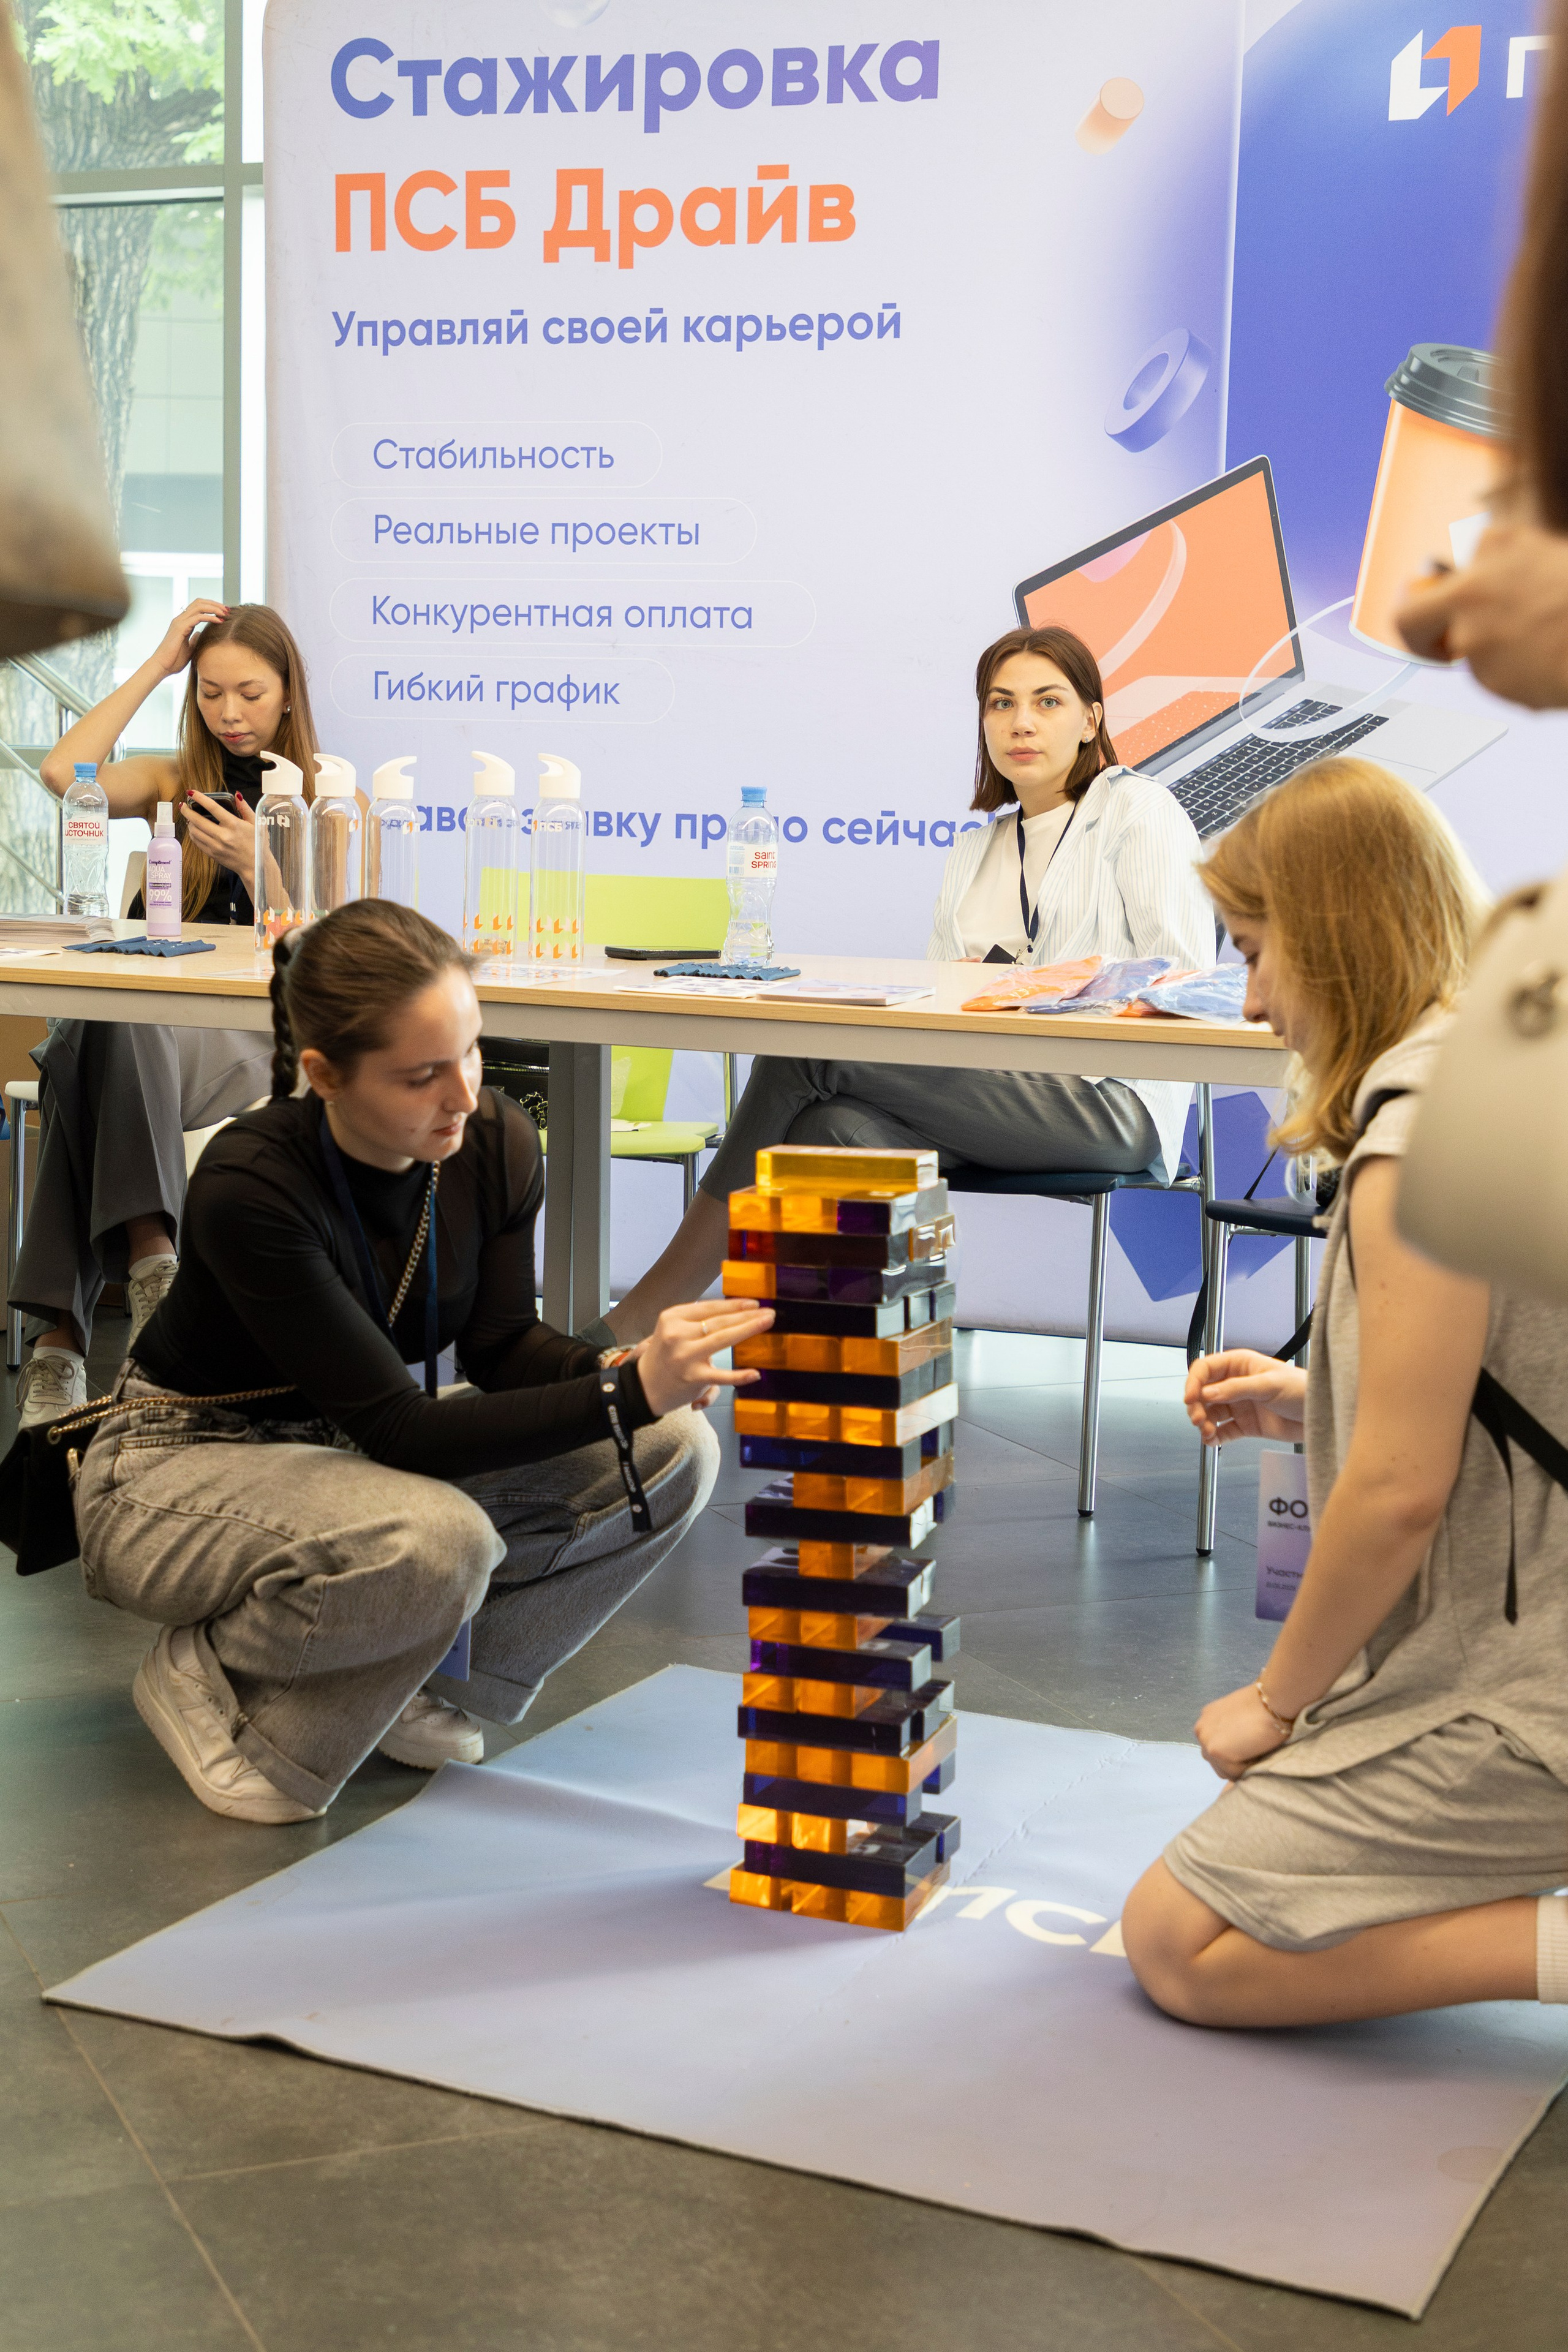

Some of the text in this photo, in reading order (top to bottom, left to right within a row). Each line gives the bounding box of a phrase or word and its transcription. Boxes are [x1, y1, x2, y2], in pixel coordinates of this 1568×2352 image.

[331, 37, 939, 133] Стажировка
[335, 164, 856, 269] ПСБ Драйв
[332, 303, 900, 356] Управляй своей карьерой
[374, 439, 614, 469] Стабильность
[375, 514, 698, 552] Реальные проекты
[373, 595, 752, 634] Конкурентная оплата
[374, 671, 619, 712] Гибкий график
[521, 809, 662, 847] звку
[675, 813, 808, 850] про
[149, 889, 172, 902] 99%
